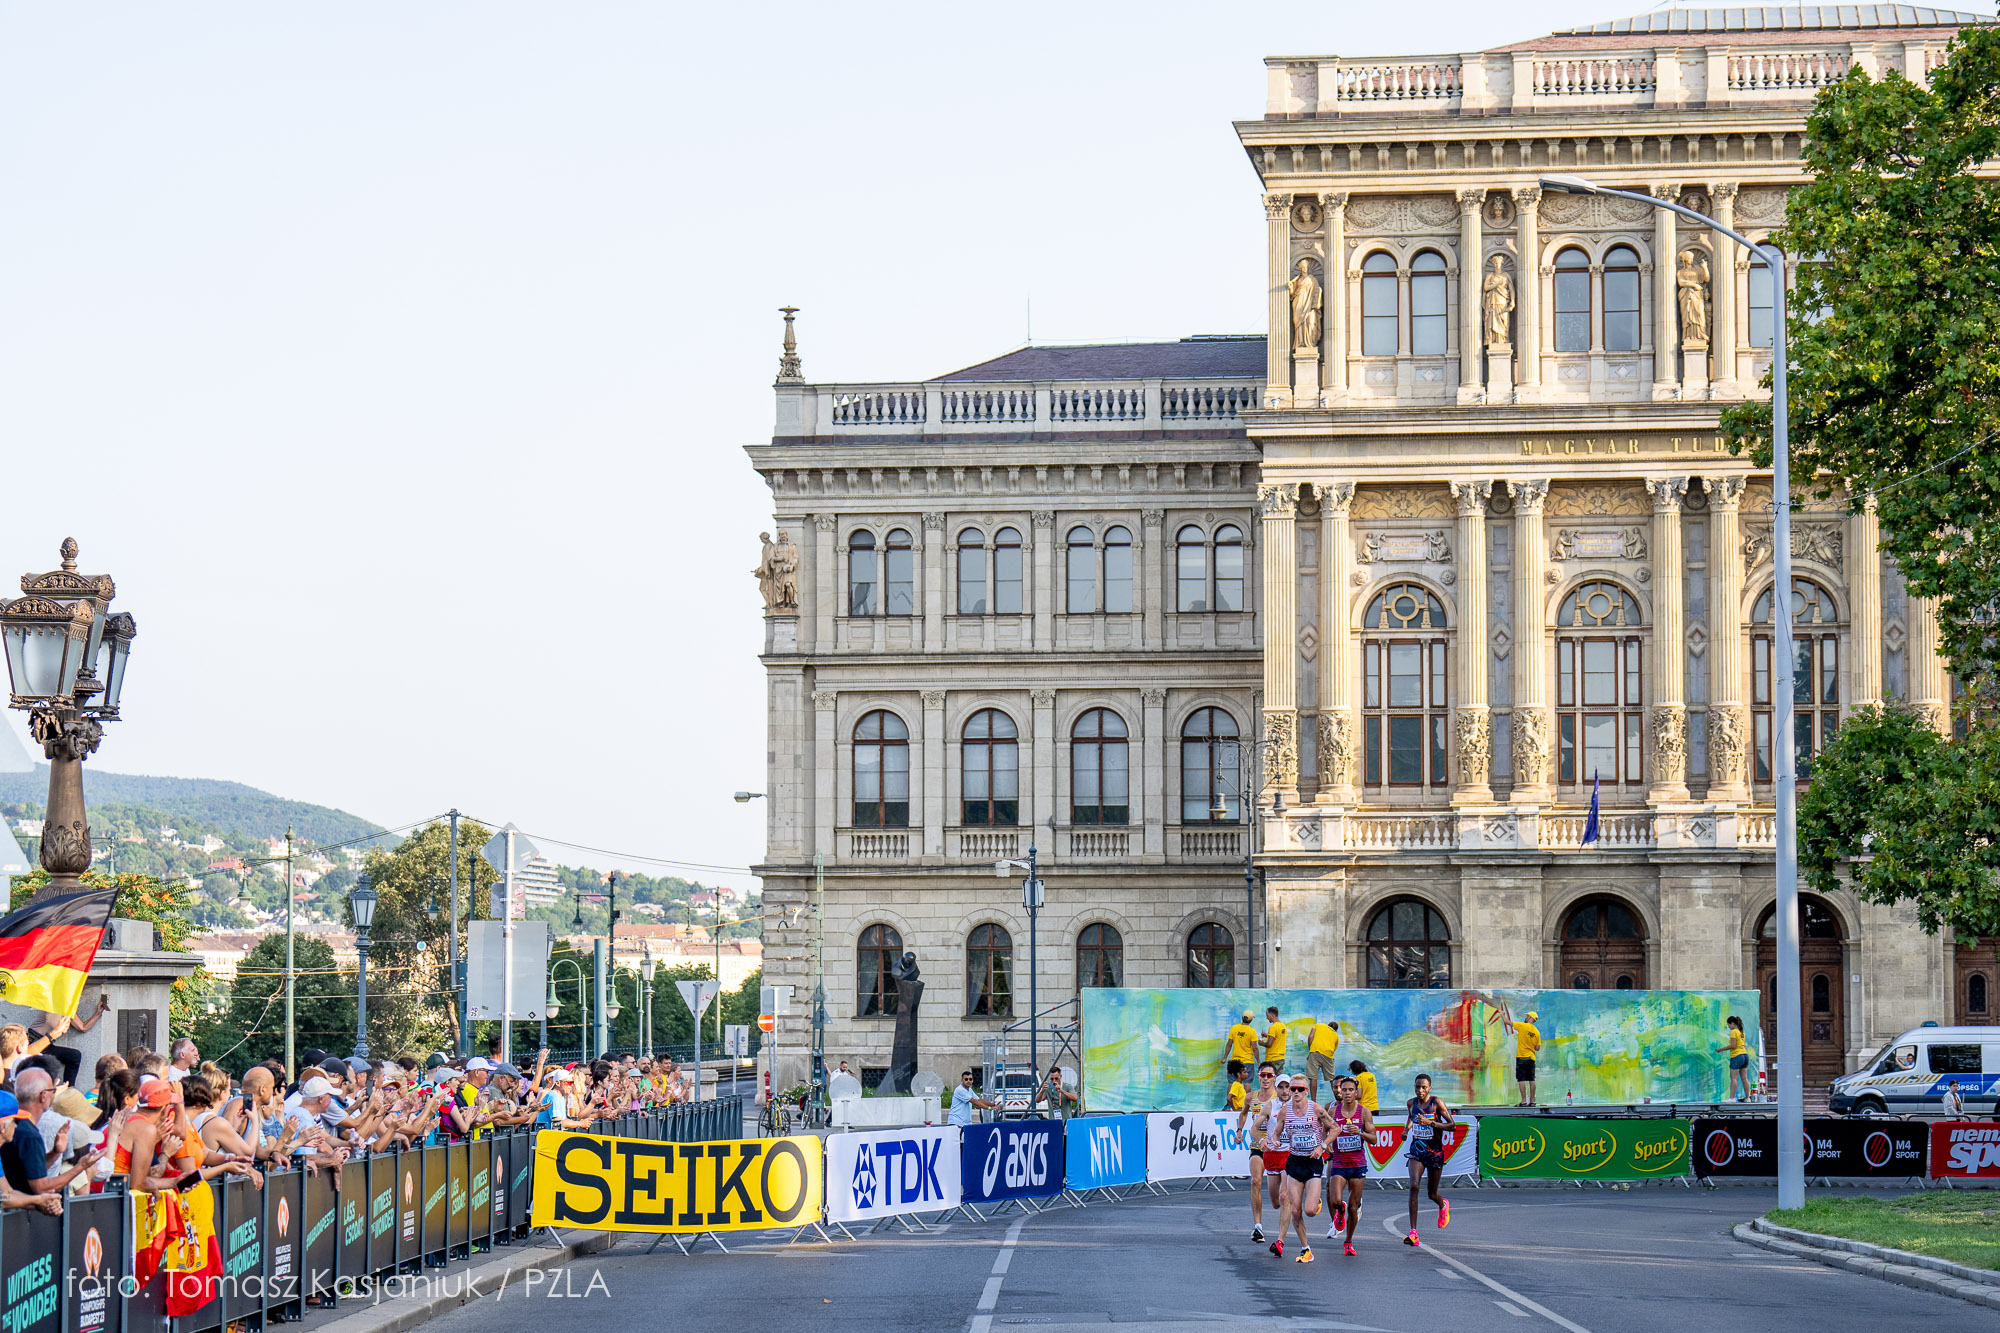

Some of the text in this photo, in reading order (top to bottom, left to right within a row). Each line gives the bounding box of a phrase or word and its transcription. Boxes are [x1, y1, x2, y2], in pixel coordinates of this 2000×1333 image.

[1521, 438, 1639, 455] MAGYAR
[1089, 1126, 1123, 1178] NTN
[1169, 1116, 1218, 1172] Tokyo
[1492, 1135, 1536, 1160] Sport
[1563, 1137, 1607, 1162] Sport
[1634, 1135, 1678, 1161] Sport
[1737, 1138, 1753, 1149] M4
[1737, 1149, 1763, 1158] SPORT
[1816, 1139, 1833, 1150] M4
[1816, 1150, 1842, 1159] SPORT
[1895, 1140, 1912, 1150] M4
[1895, 1151, 1921, 1159] SPORT
[876, 1137, 944, 1206] TDK
[1005, 1131, 1050, 1189] asics
[555, 1136, 807, 1226] SEIKO
[229, 1216, 257, 1255] WITNESS
[374, 1207, 395, 1240] WONDER
[232, 1241, 260, 1279] WONDER
[8, 1253, 52, 1306] WITNESS
[2, 1311, 12, 1330] THE
[12, 1284, 57, 1333] WONDER
